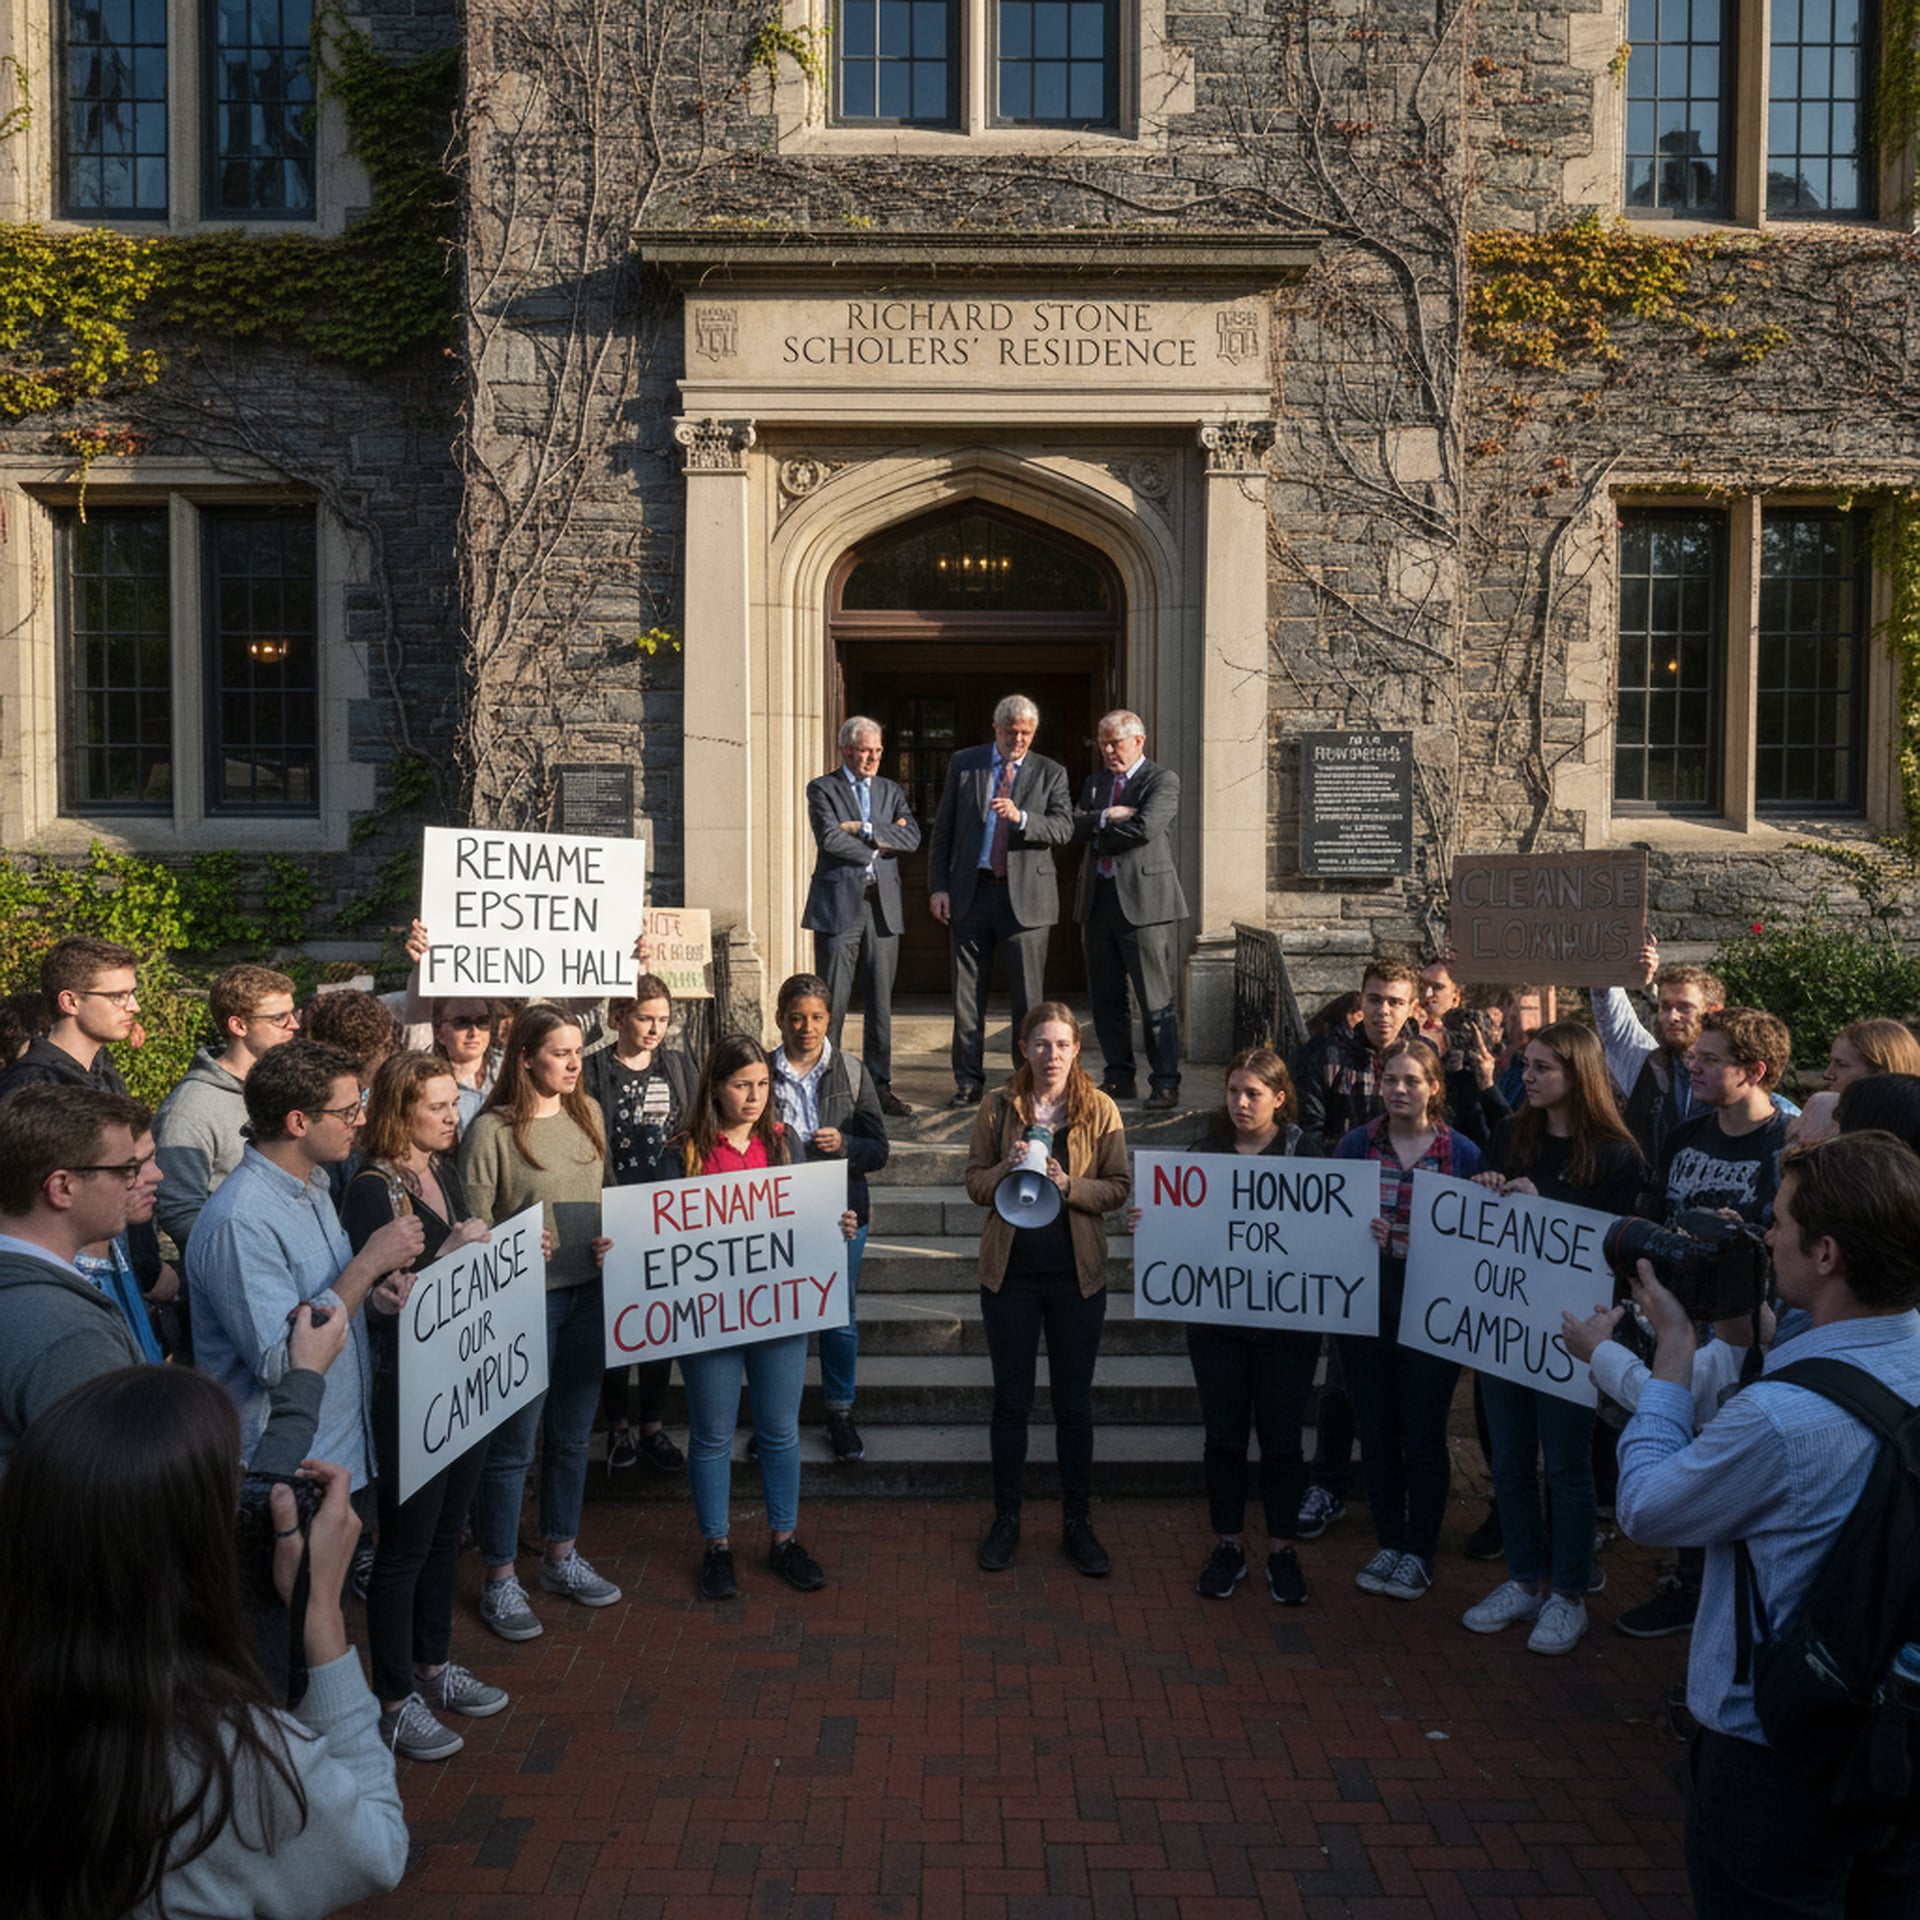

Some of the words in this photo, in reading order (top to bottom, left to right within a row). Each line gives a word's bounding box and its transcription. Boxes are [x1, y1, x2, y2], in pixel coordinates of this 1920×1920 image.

[846, 303, 1013, 332] RICHARD
[1034, 303, 1153, 332] STONE
[783, 336, 979, 366] SCHOLERS'
[999, 338, 1197, 367] RESIDENCE
[456, 837, 605, 884] RENAME
[1460, 860, 1643, 911] CLEANSE
[455, 891, 598, 932] EPSTEN
[429, 944, 544, 985] FRIEND
[562, 948, 633, 985] HALL
[653, 1176, 795, 1235] RENAME
[1154, 1165, 1207, 1208] NO
[1232, 1170, 1353, 1218] HONOR
[1228, 1221, 1288, 1255] FOR
[1431, 1190, 1596, 1273] CLEANSE
[644, 1228, 794, 1290] EPSTEN
[1475, 1258, 1529, 1306] OUR
[414, 1229, 528, 1342] CLEANSE
[613, 1271, 837, 1352] COMPLICITY
[458, 1310, 495, 1362] OUR
[1425, 1297, 1574, 1383] CAMPUS
[423, 1332, 529, 1454] CAMPUS
